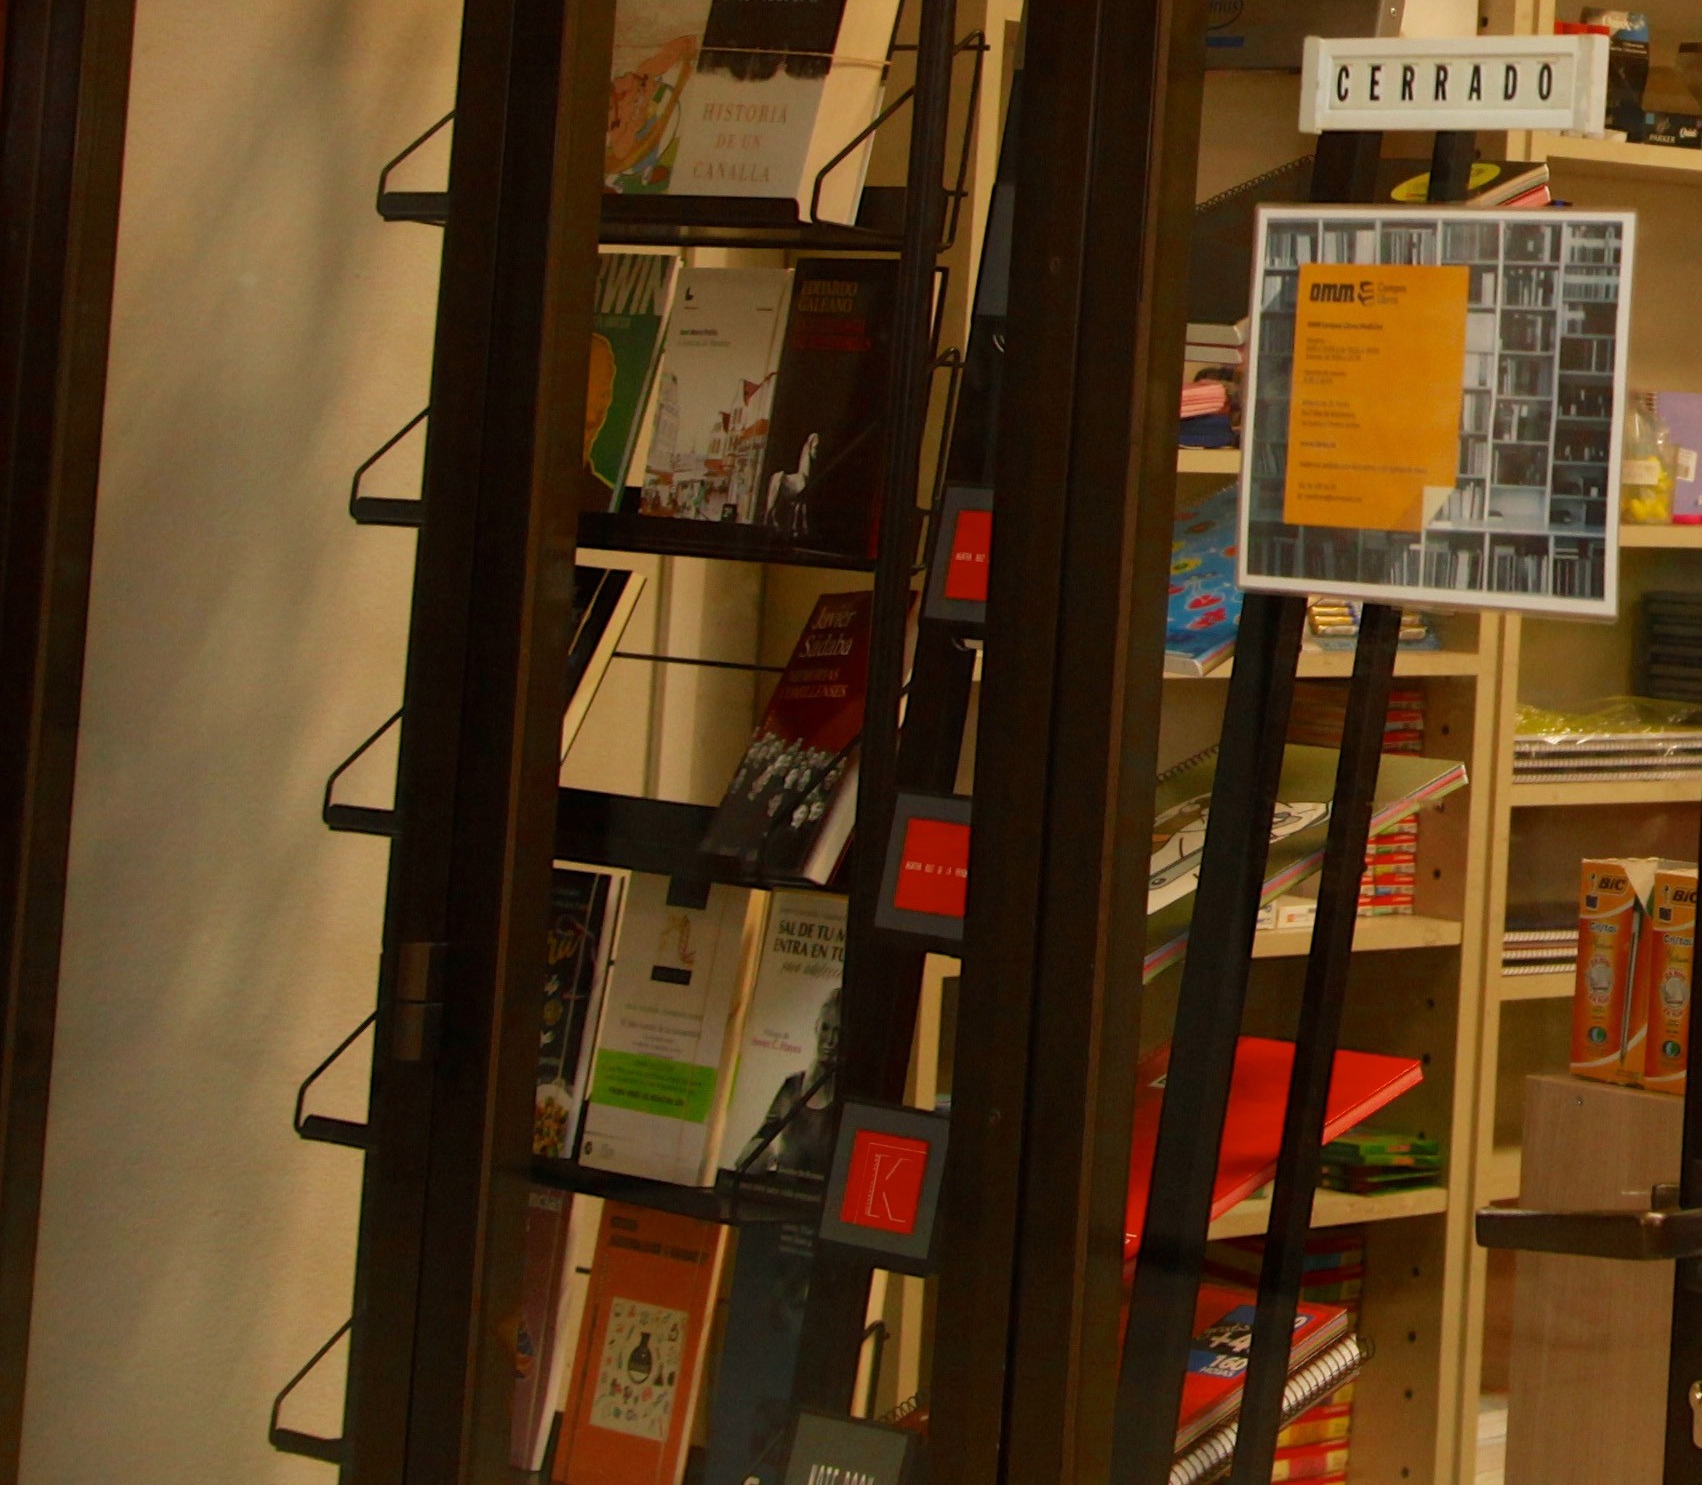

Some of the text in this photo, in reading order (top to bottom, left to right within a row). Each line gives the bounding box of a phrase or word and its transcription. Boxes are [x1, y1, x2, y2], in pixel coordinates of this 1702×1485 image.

[1336, 64, 1554, 102] CERRADO
[701, 101, 788, 125] HISTORIA
[715, 133, 736, 150] DE
[691, 163, 772, 183] CANALLA
[815, 606, 855, 631] Javier
[803, 633, 854, 658] Sádaba
[777, 919, 796, 936] SAL
[798, 922, 814, 939] DE
[772, 937, 829, 959] ENTRA EN
